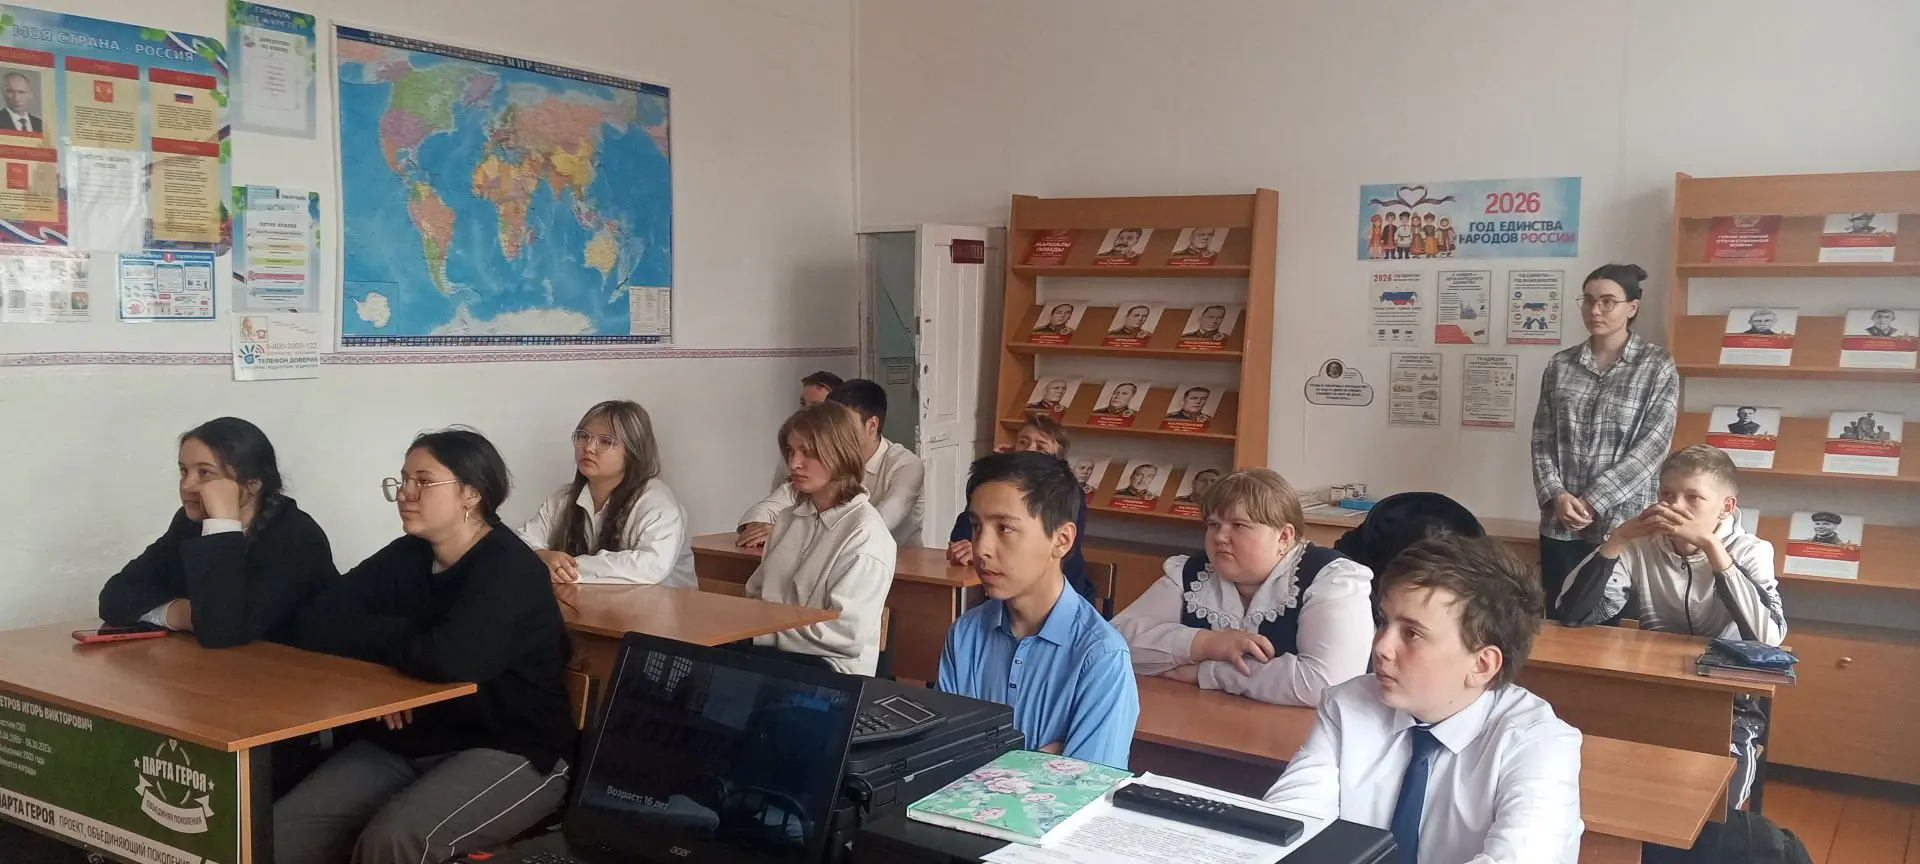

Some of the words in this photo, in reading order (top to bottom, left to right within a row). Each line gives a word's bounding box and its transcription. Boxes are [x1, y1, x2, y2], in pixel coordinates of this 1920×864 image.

[13, 25, 53, 41] МОЯ
[58, 32, 120, 51] СТРАНА
[135, 43, 194, 62] РОССИЯ
[1485, 191, 1541, 214] 2026
[1469, 221, 1495, 233] ГОД
[1499, 220, 1563, 232] ЕДИНСТВА
[1459, 233, 1519, 245] НАРОДОВ
[289, 356, 320, 364] ДОВЕРИЯ
[0, 694, 22, 712] ЕТРОВ
[21, 700, 44, 719] ИГОРЬ
[44, 706, 93, 732] ВИКТОРОВИЧ
[142, 755, 174, 782] ПАРТА
[175, 764, 207, 793] ГЕРОЯ
[607, 785, 643, 803] Возраст:
[643, 795, 654, 806] 16
[654, 801, 669, 810] лет
[0, 792, 24, 814] АРТА
[25, 801, 55, 827] ГЕРОЯ
[59, 815, 88, 838] ПРОЕКТ,
[87, 826, 146, 859] ОБЪЕДИНЯЮЩИЙ
[173, 814, 202, 826] ПОКОЛЕНИЯ
[670, 845, 692, 858] acer
